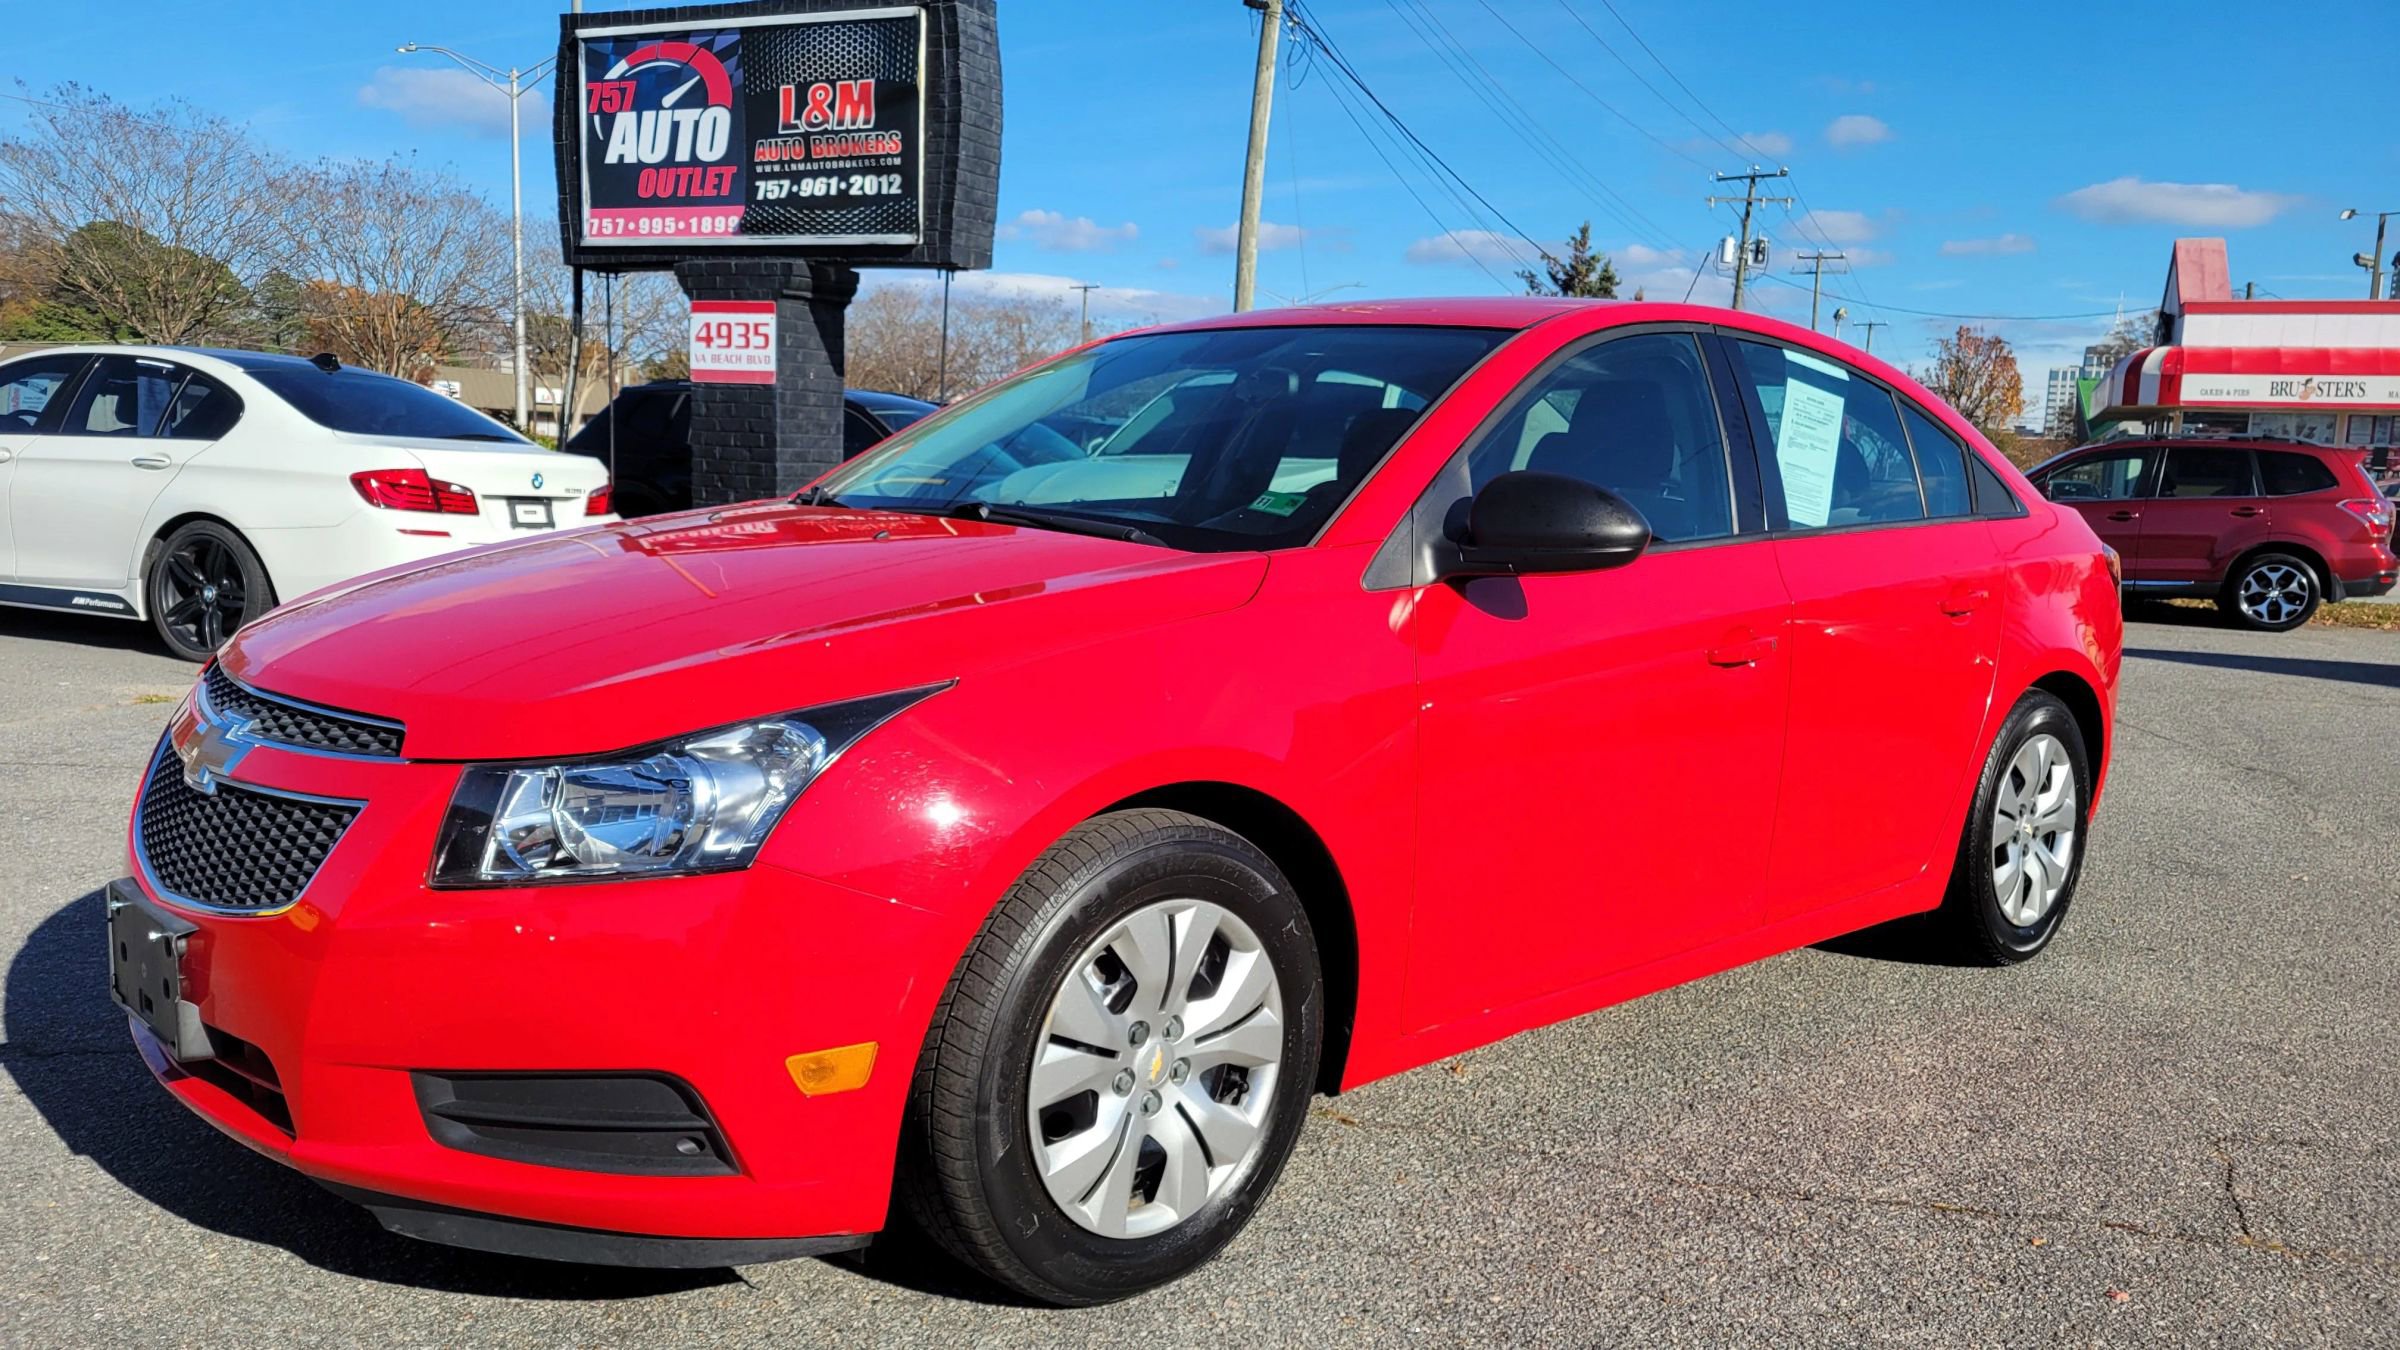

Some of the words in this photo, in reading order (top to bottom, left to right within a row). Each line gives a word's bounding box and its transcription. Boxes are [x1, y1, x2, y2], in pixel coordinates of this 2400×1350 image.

[587, 81, 637, 113] 757
[778, 79, 876, 134] L&M
[604, 106, 731, 164] AUTO
[754, 138, 805, 162] AUTO
[810, 130, 902, 158] BROKERS
[755, 157, 902, 173] WWW.LNMAUTOBROKERS.COM
[637, 166, 738, 198] OUTLET
[695, 322, 770, 349] 4935
[695, 354, 706, 364] VA
[711, 354, 741, 364] BEACH
[746, 355, 771, 364] BLVD
[85, 598, 124, 609] Performance
